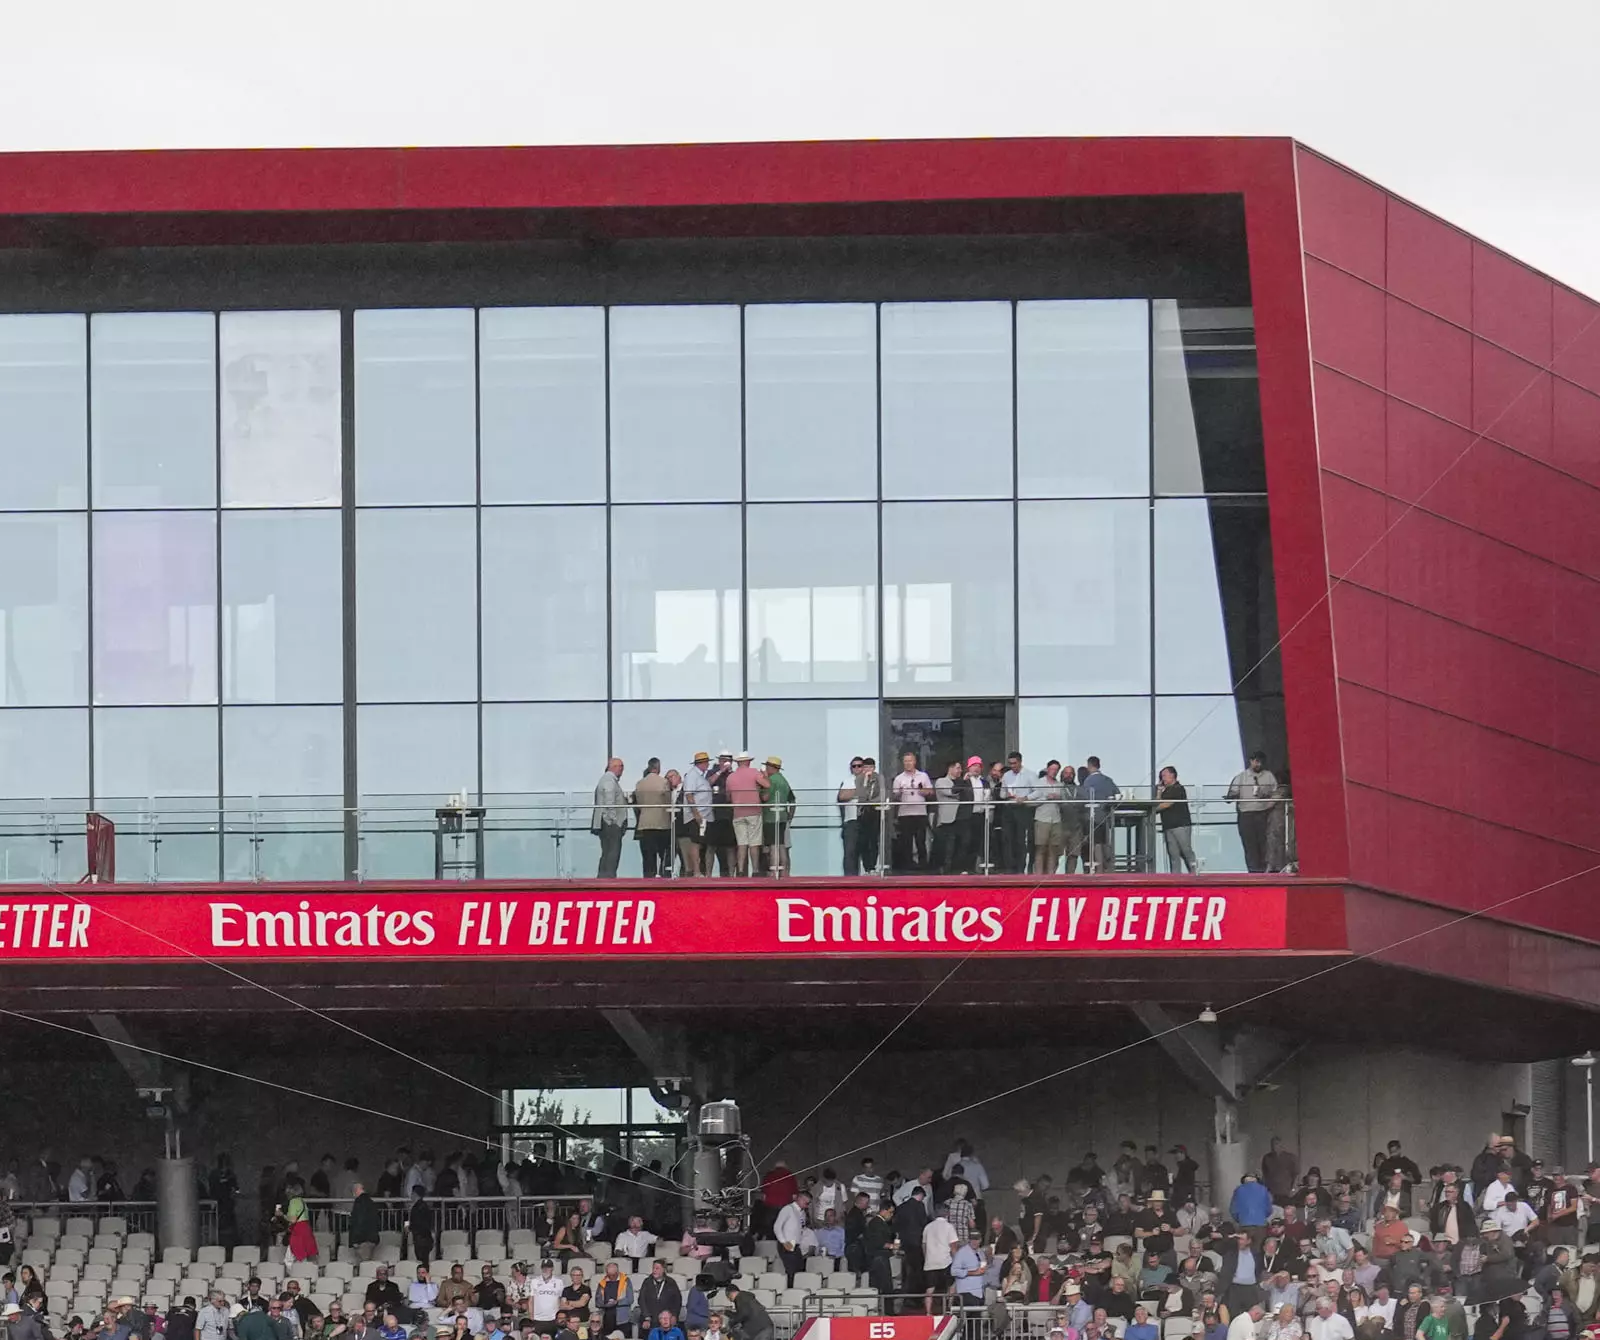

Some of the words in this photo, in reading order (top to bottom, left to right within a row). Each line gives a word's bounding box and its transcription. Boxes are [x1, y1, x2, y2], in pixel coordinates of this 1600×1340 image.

[209, 901, 435, 946] Emirates
[458, 902, 518, 946] FLY
[529, 901, 655, 945] BETTER
[776, 896, 1003, 942] Emirates
[1026, 897, 1087, 942] FLY
[1097, 896, 1226, 941] BETTER
[869, 1322, 896, 1339] E5
